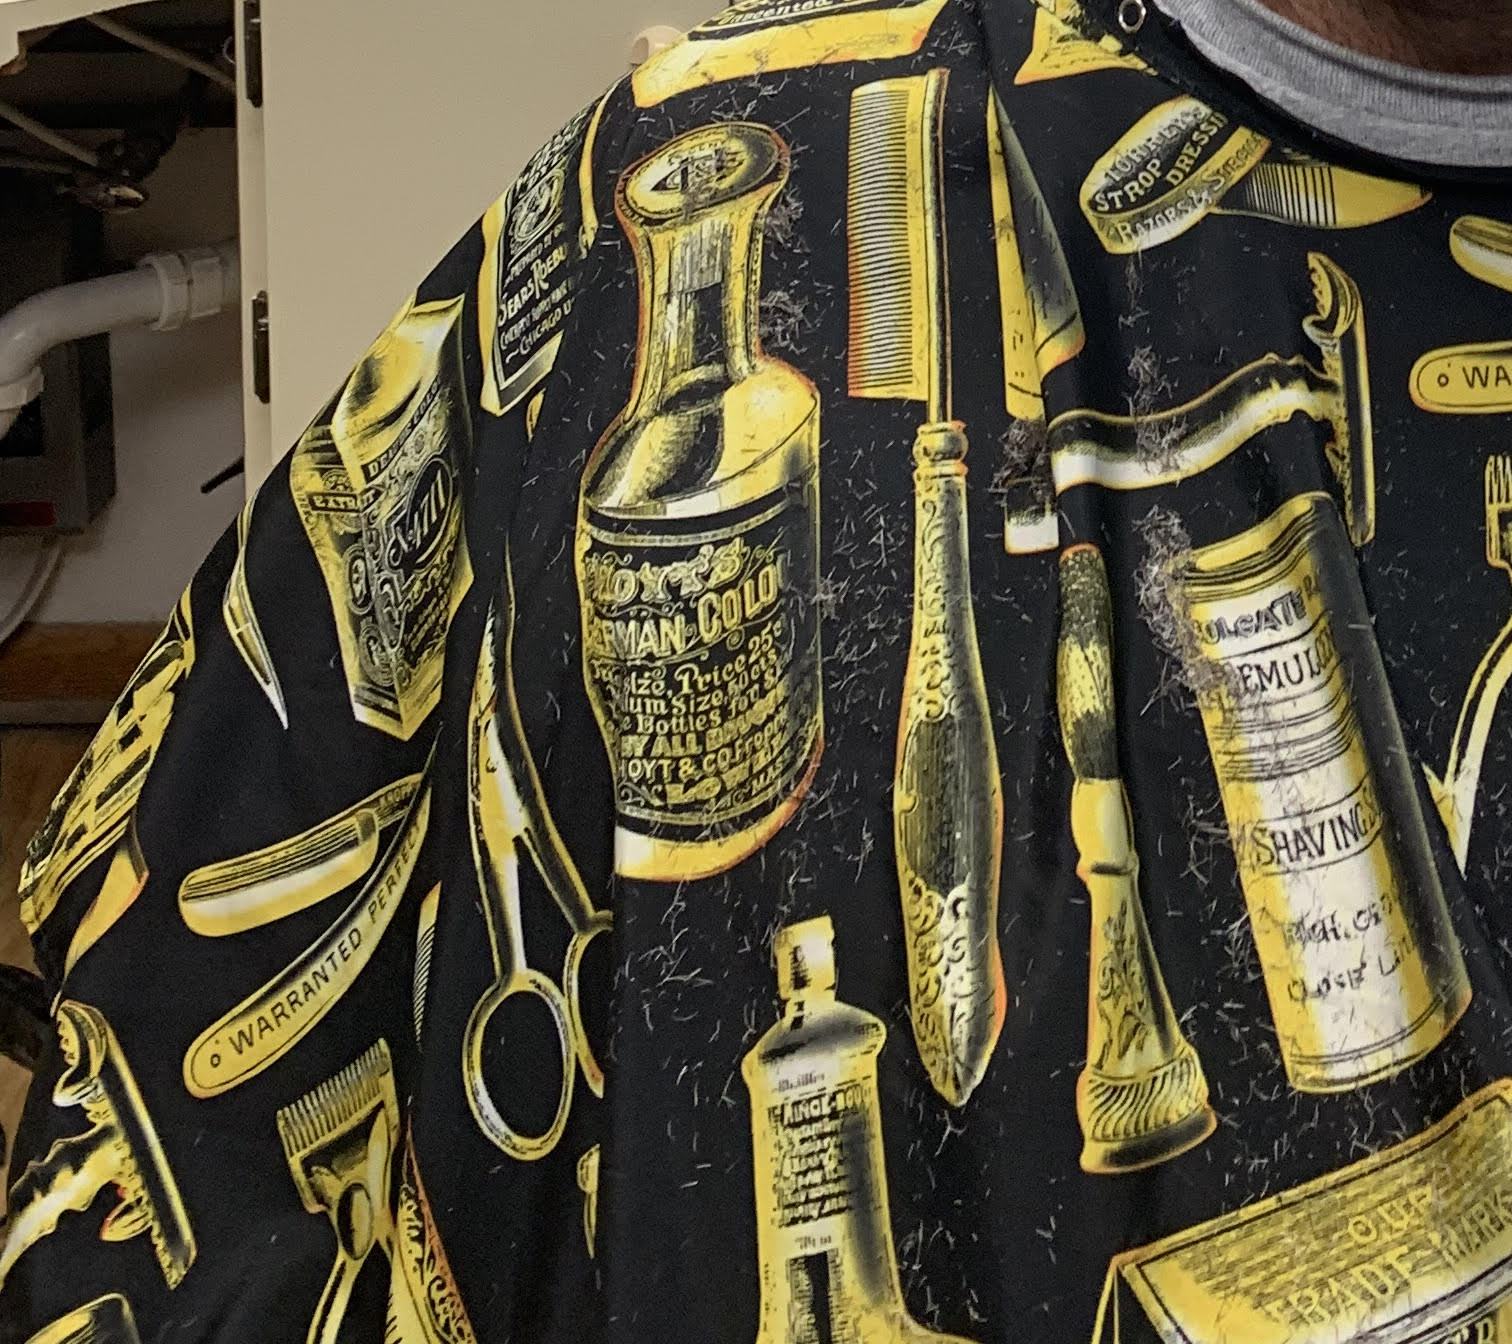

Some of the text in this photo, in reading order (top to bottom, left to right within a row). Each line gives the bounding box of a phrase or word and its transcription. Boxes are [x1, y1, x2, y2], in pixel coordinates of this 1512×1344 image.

[1094, 158, 1163, 213] STROP
[674, 654, 747, 695] Price
[636, 708, 722, 736] Bottles
[228, 926, 363, 1056] WARRANTED
